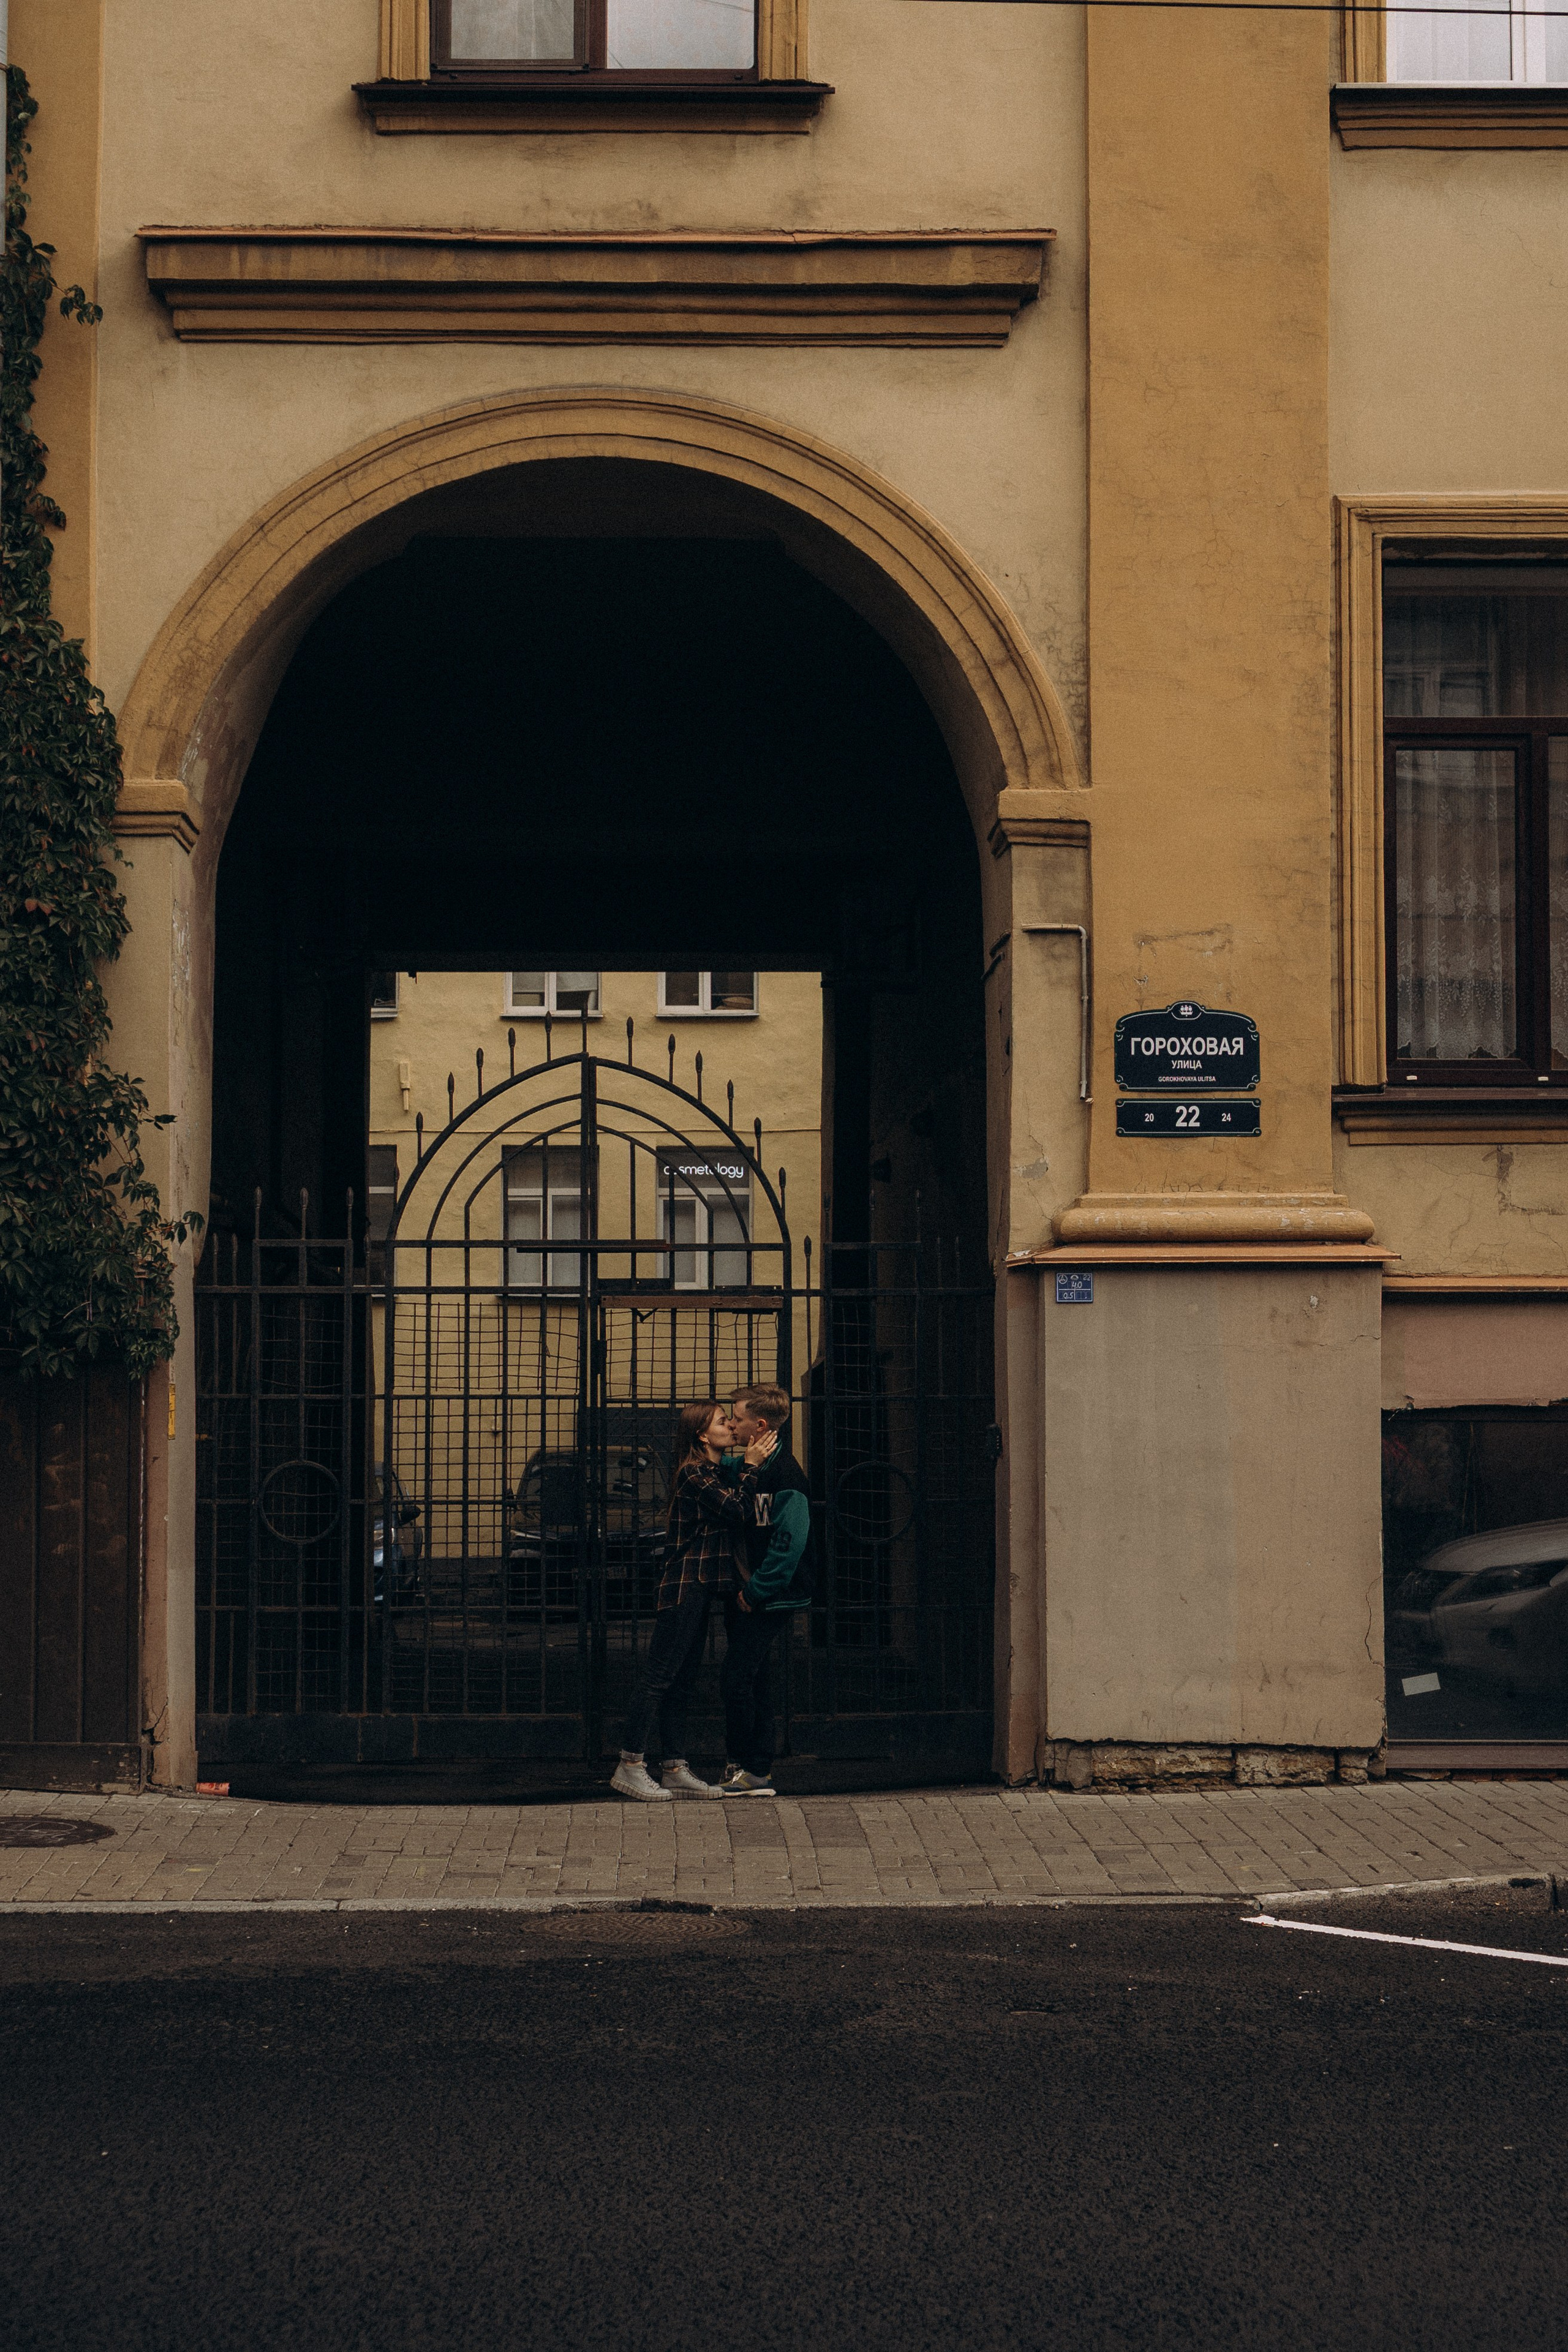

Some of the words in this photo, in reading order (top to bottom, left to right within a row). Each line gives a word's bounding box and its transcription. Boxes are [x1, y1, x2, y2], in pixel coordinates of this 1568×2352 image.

[1131, 1037, 1244, 1055] ГОРОХОВАЯ
[1171, 1060, 1202, 1071] УЛИЦА
[1144, 1113, 1155, 1122] 20
[1175, 1105, 1200, 1127] 22
[1221, 1112, 1232, 1122] 24
[663, 1163, 744, 1178] csmetlogy
